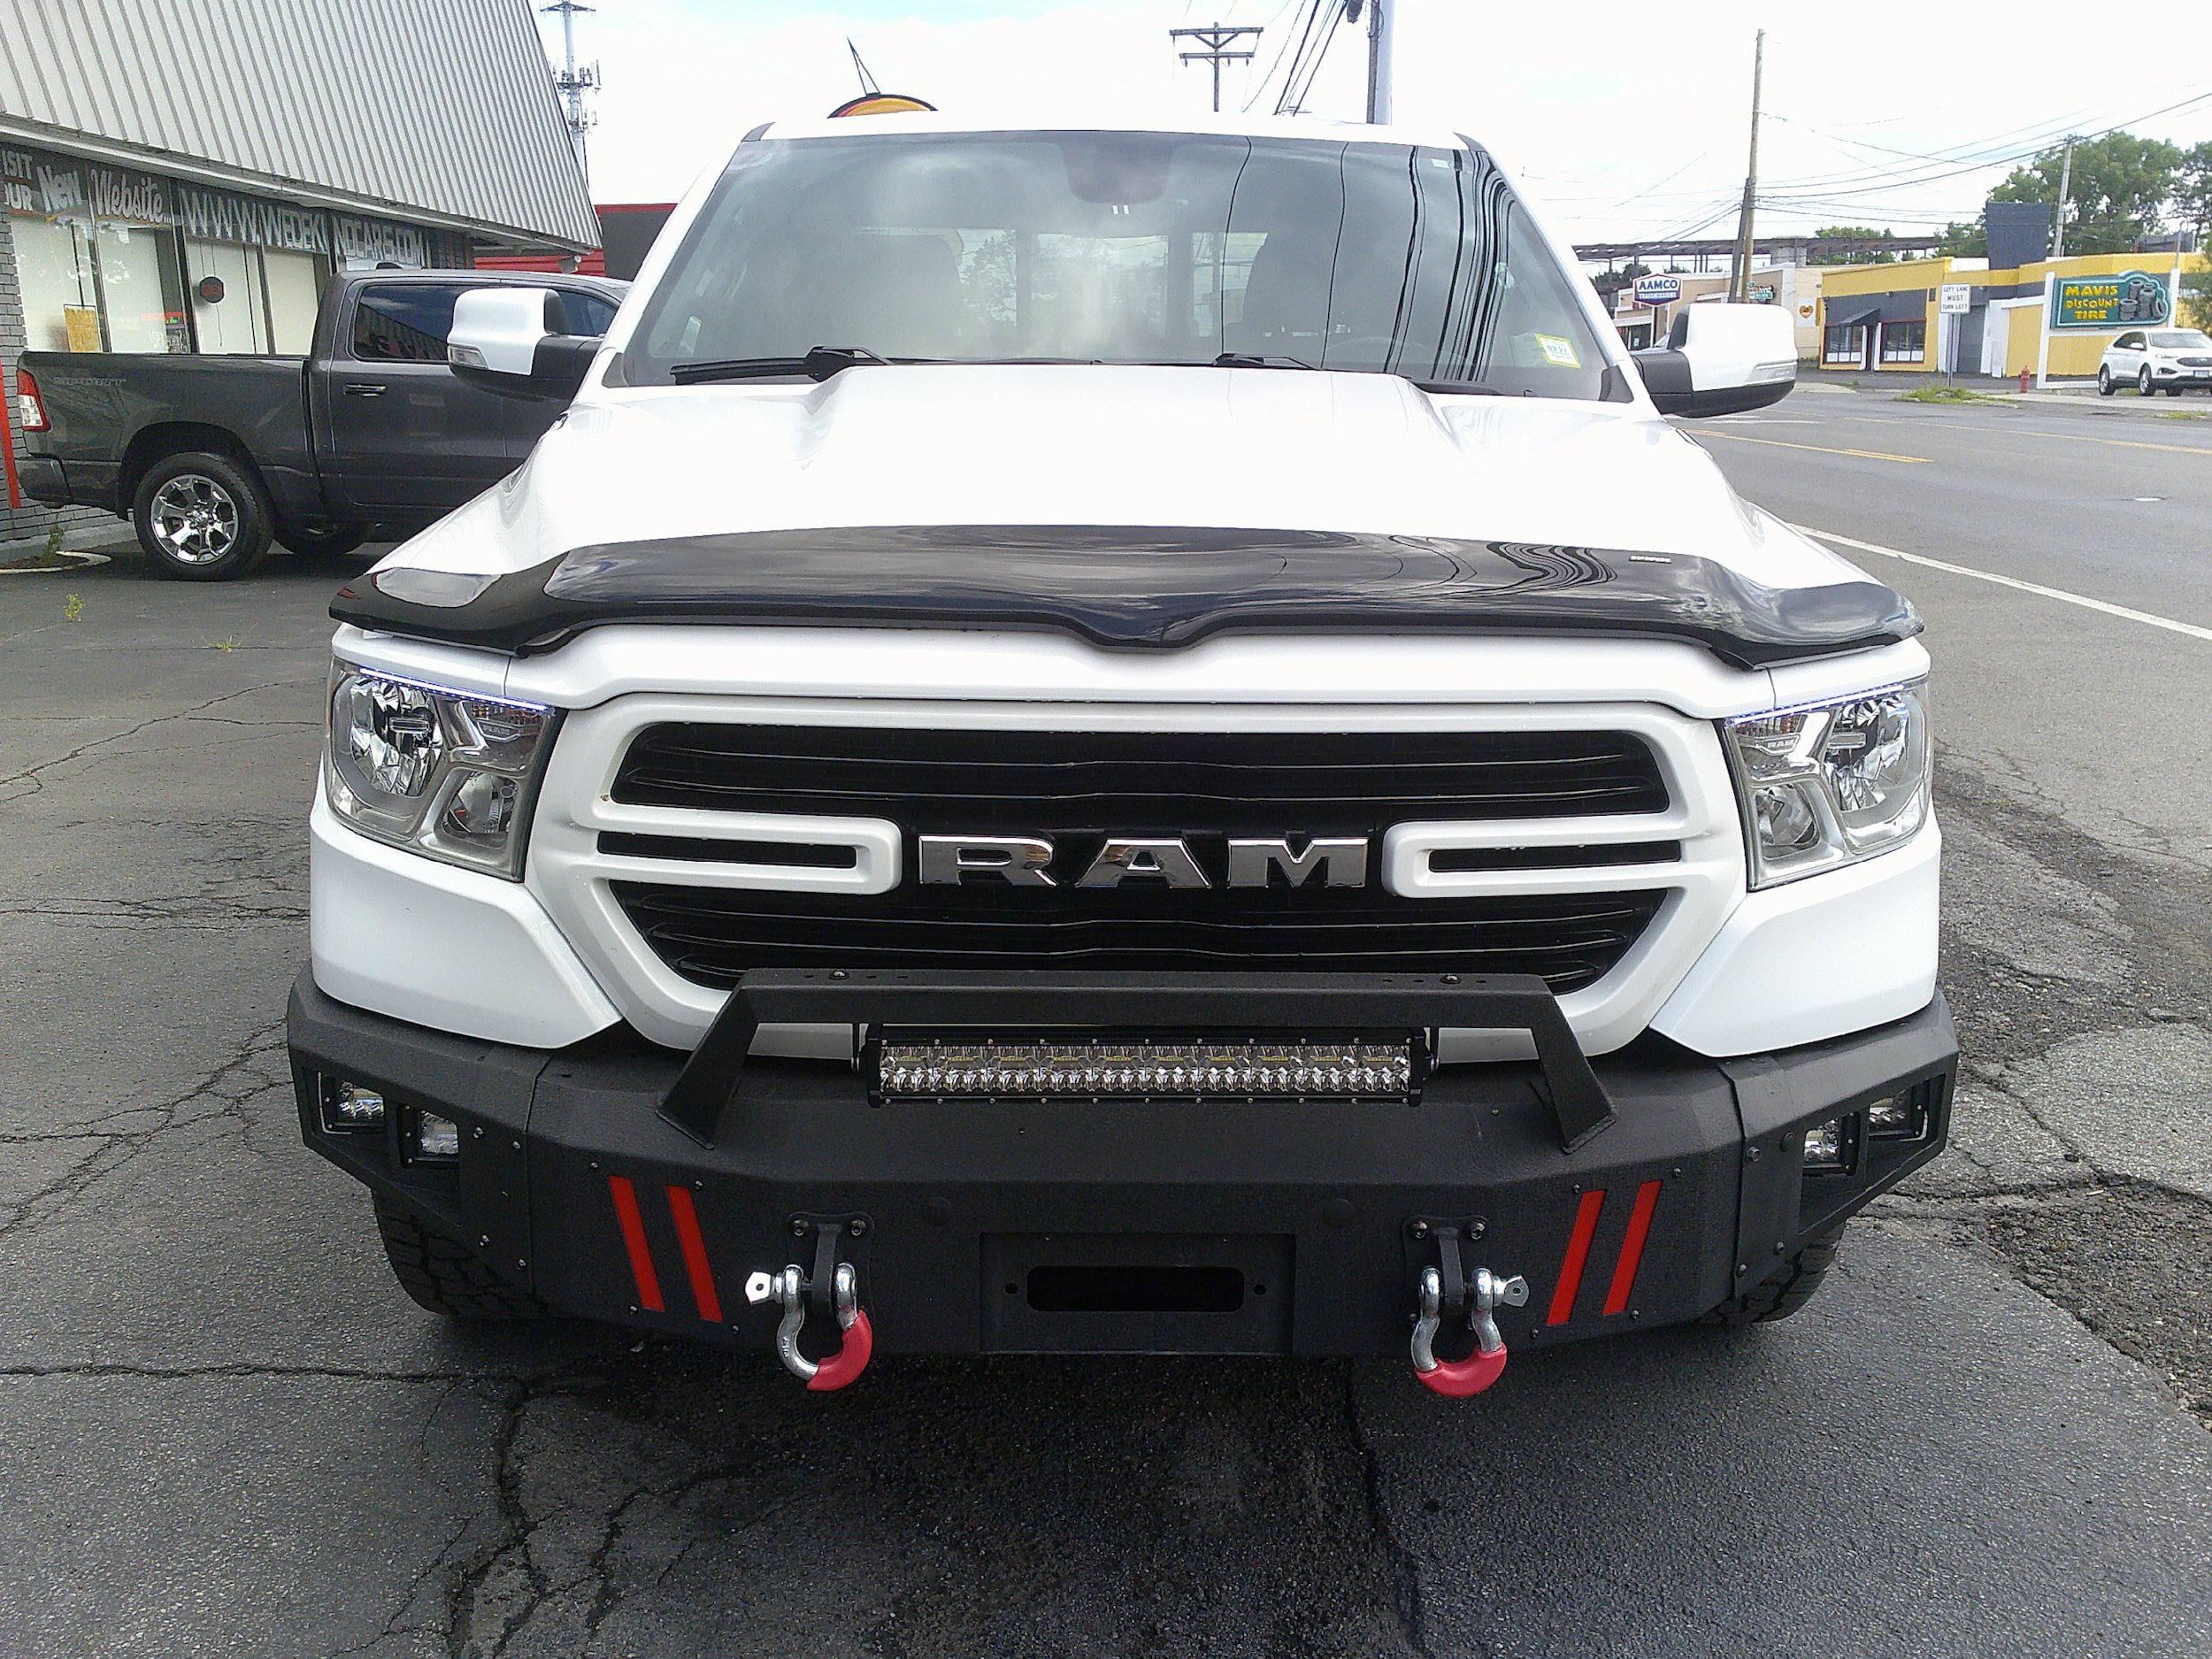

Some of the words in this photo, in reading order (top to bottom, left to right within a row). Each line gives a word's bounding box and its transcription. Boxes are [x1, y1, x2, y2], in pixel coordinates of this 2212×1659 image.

[0, 148, 33, 180] ISIT
[1639, 280, 1678, 290] AAMCO
[2065, 285, 2118, 296] MAVIS
[2066, 297, 2119, 309] DISCOUNT
[2074, 310, 2108, 319] TIRE
[918, 835, 1370, 889] RAM
